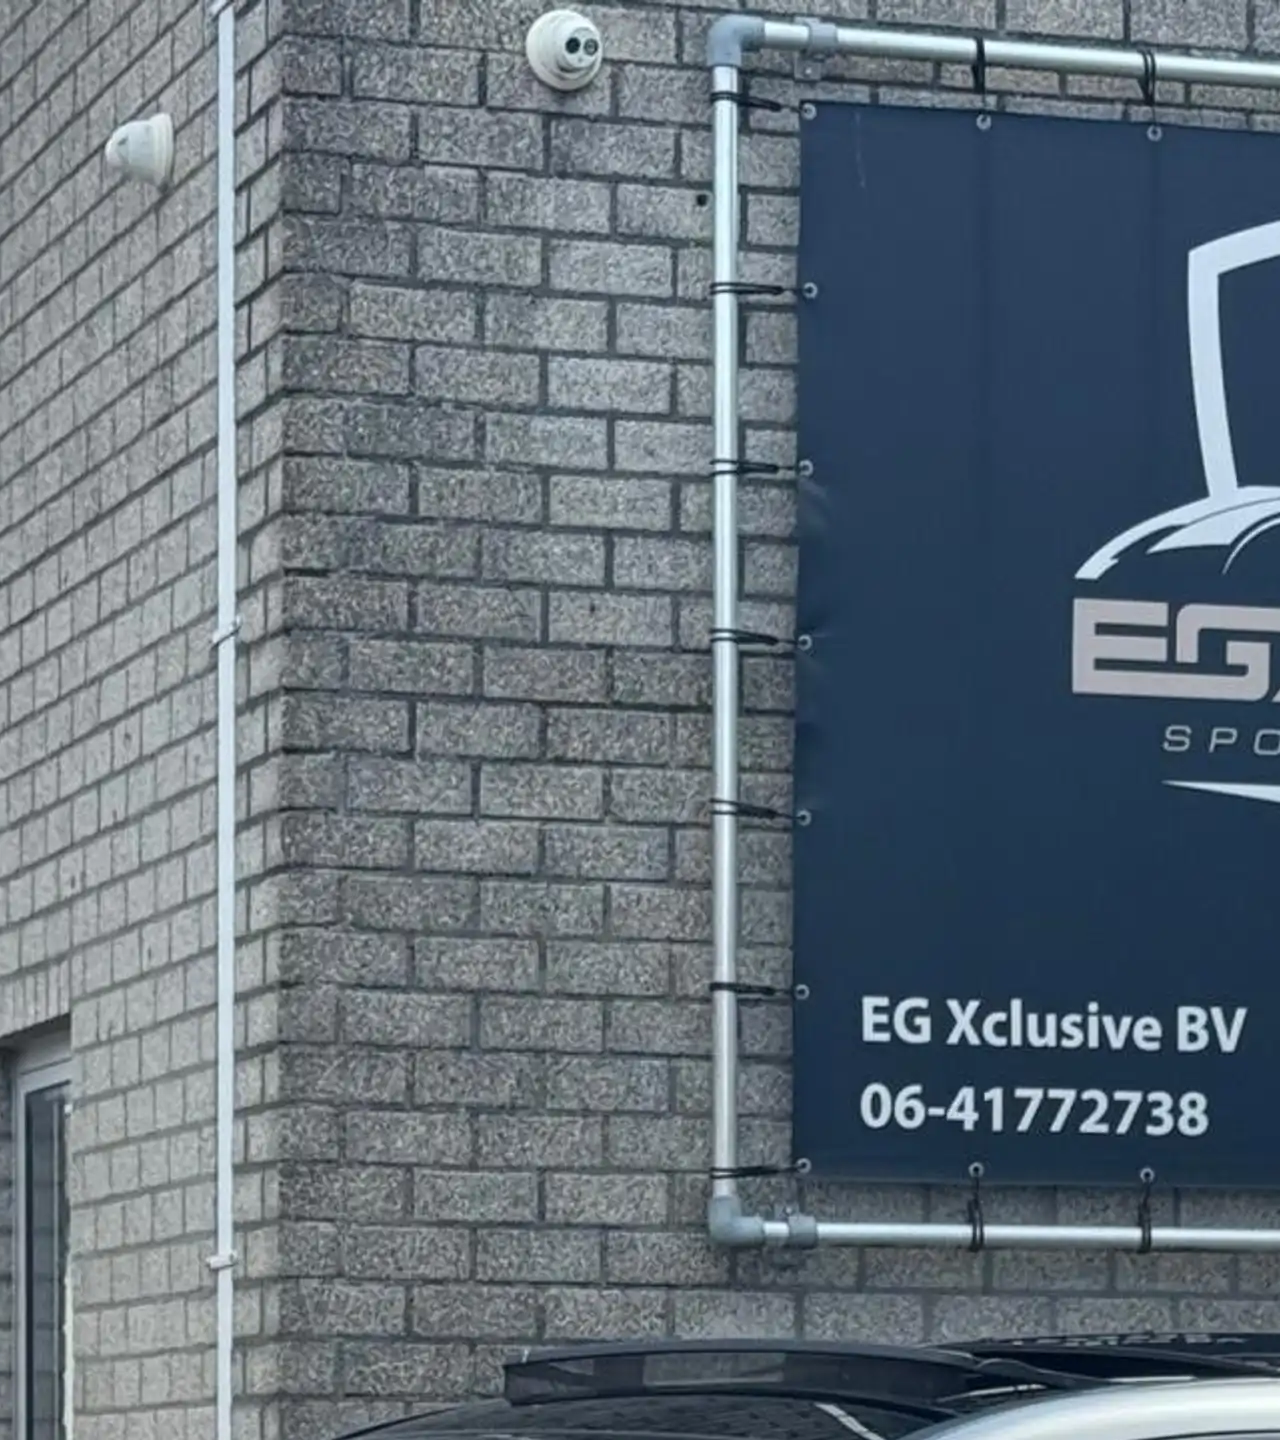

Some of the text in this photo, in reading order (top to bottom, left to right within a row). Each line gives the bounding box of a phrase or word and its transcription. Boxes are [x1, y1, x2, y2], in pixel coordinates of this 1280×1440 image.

[861, 995, 1248, 1053] EG Xclusive BV
[860, 1082, 1209, 1136] 06-41772738
